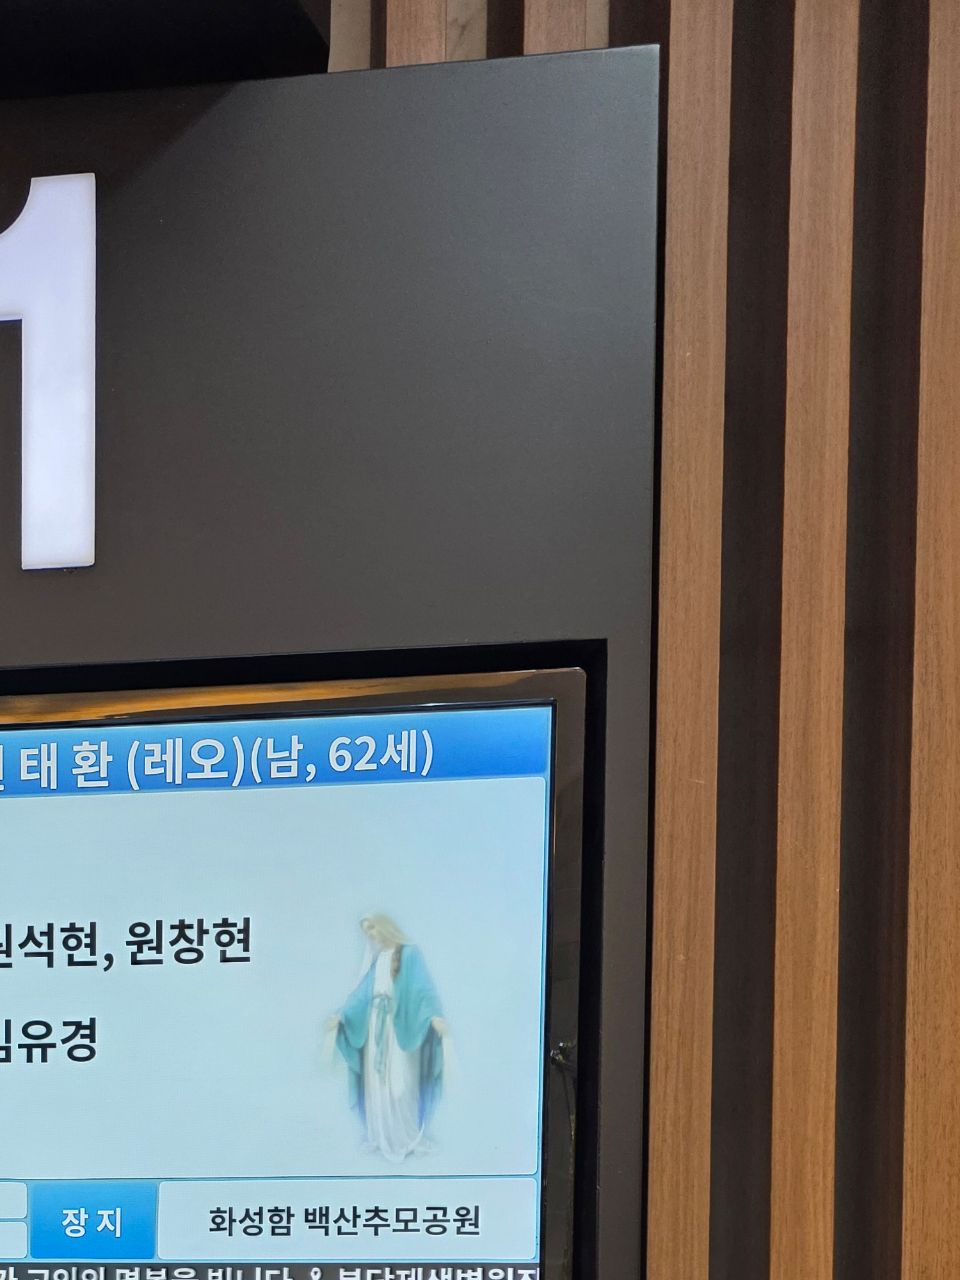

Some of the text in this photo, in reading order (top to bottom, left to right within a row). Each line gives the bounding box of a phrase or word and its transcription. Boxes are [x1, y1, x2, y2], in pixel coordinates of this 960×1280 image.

[328, 729, 434, 777] 62세)
[124, 917, 252, 966] 원창현
[208, 1205, 481, 1237] 화성함 백산추모공원
